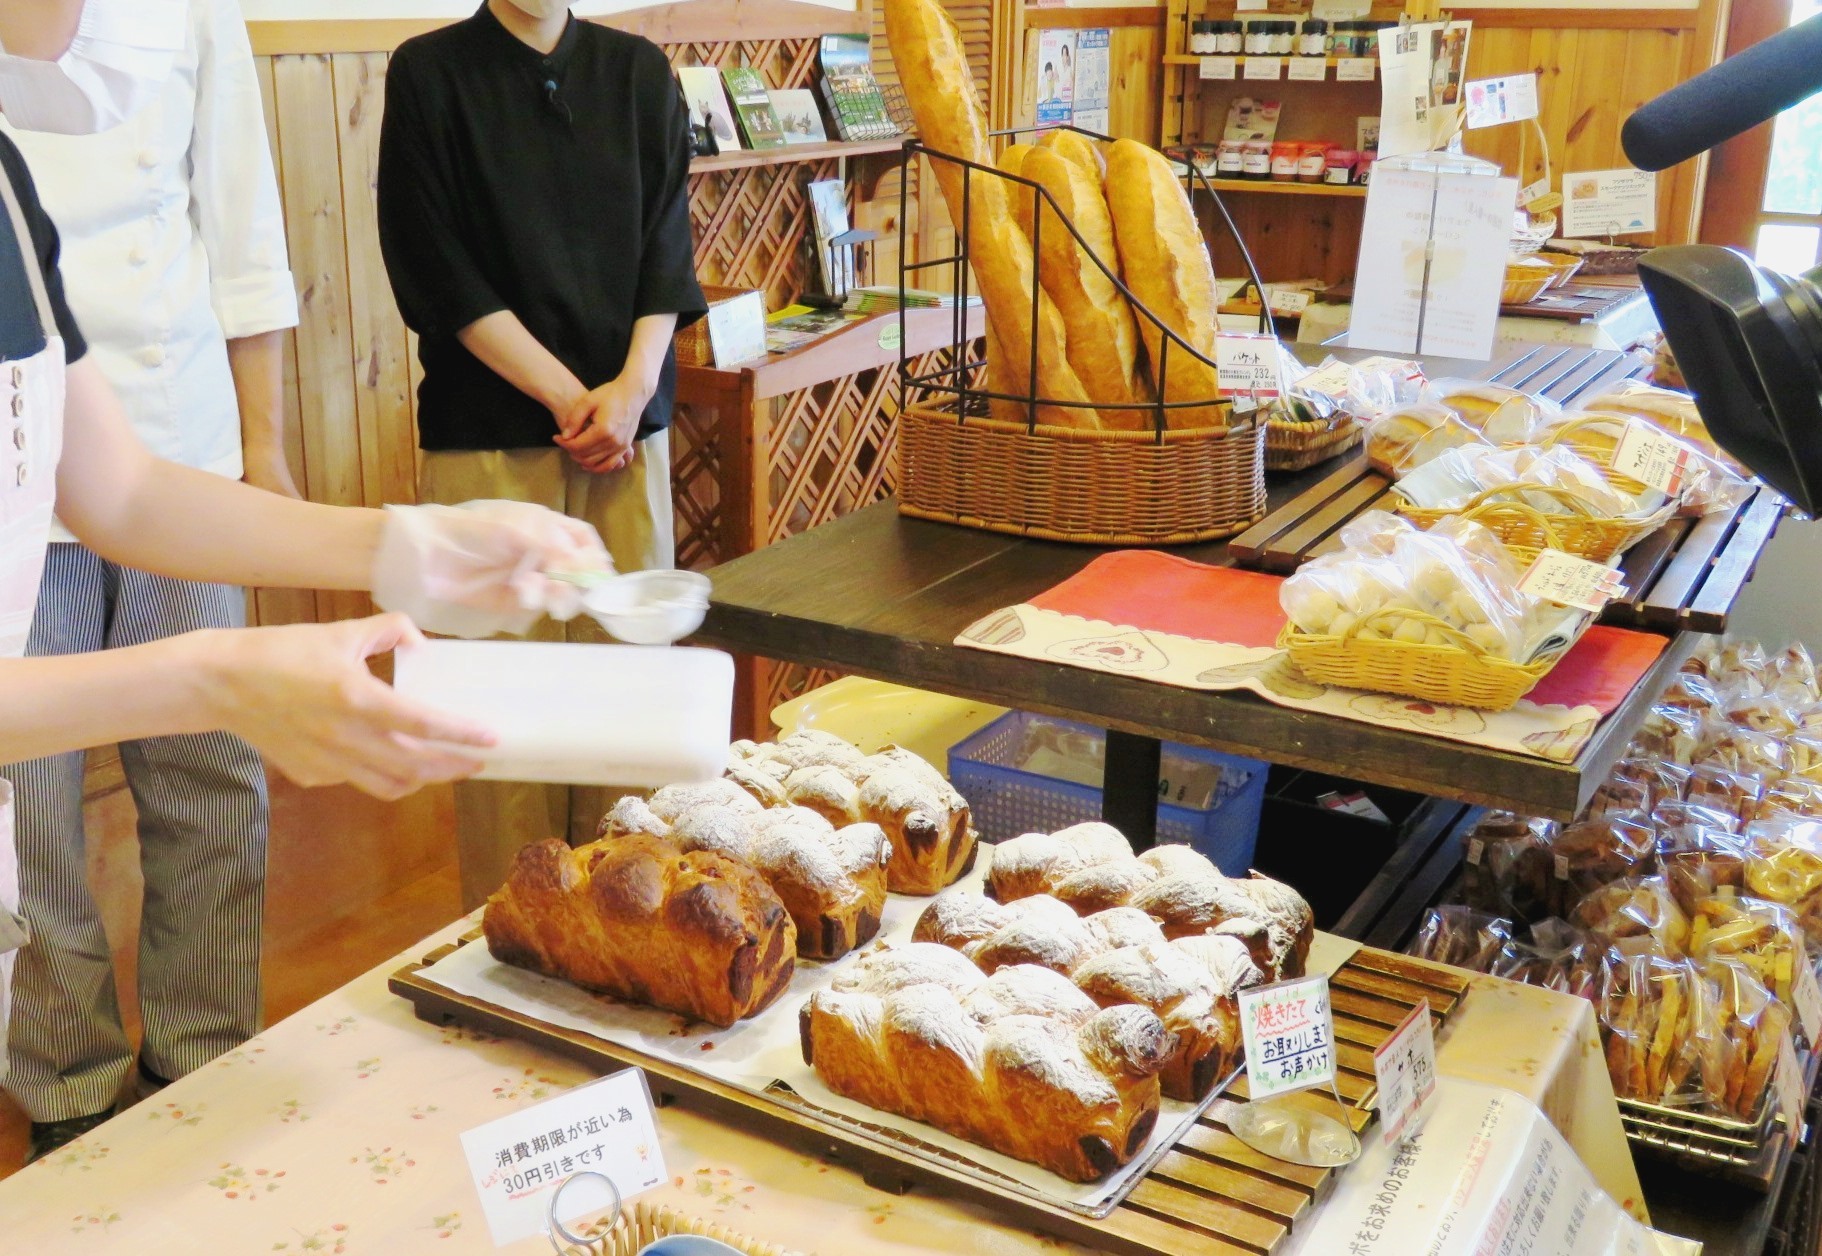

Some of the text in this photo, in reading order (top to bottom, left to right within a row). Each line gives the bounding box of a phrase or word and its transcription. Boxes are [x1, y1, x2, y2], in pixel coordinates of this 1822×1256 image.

[1254, 367, 1270, 379] 232
[1254, 999, 1306, 1029] 焼きたて
[1413, 1056, 1427, 1081] 575
[495, 1106, 633, 1168] 消費期限が近い為
[503, 1143, 606, 1194] 30円引きです
